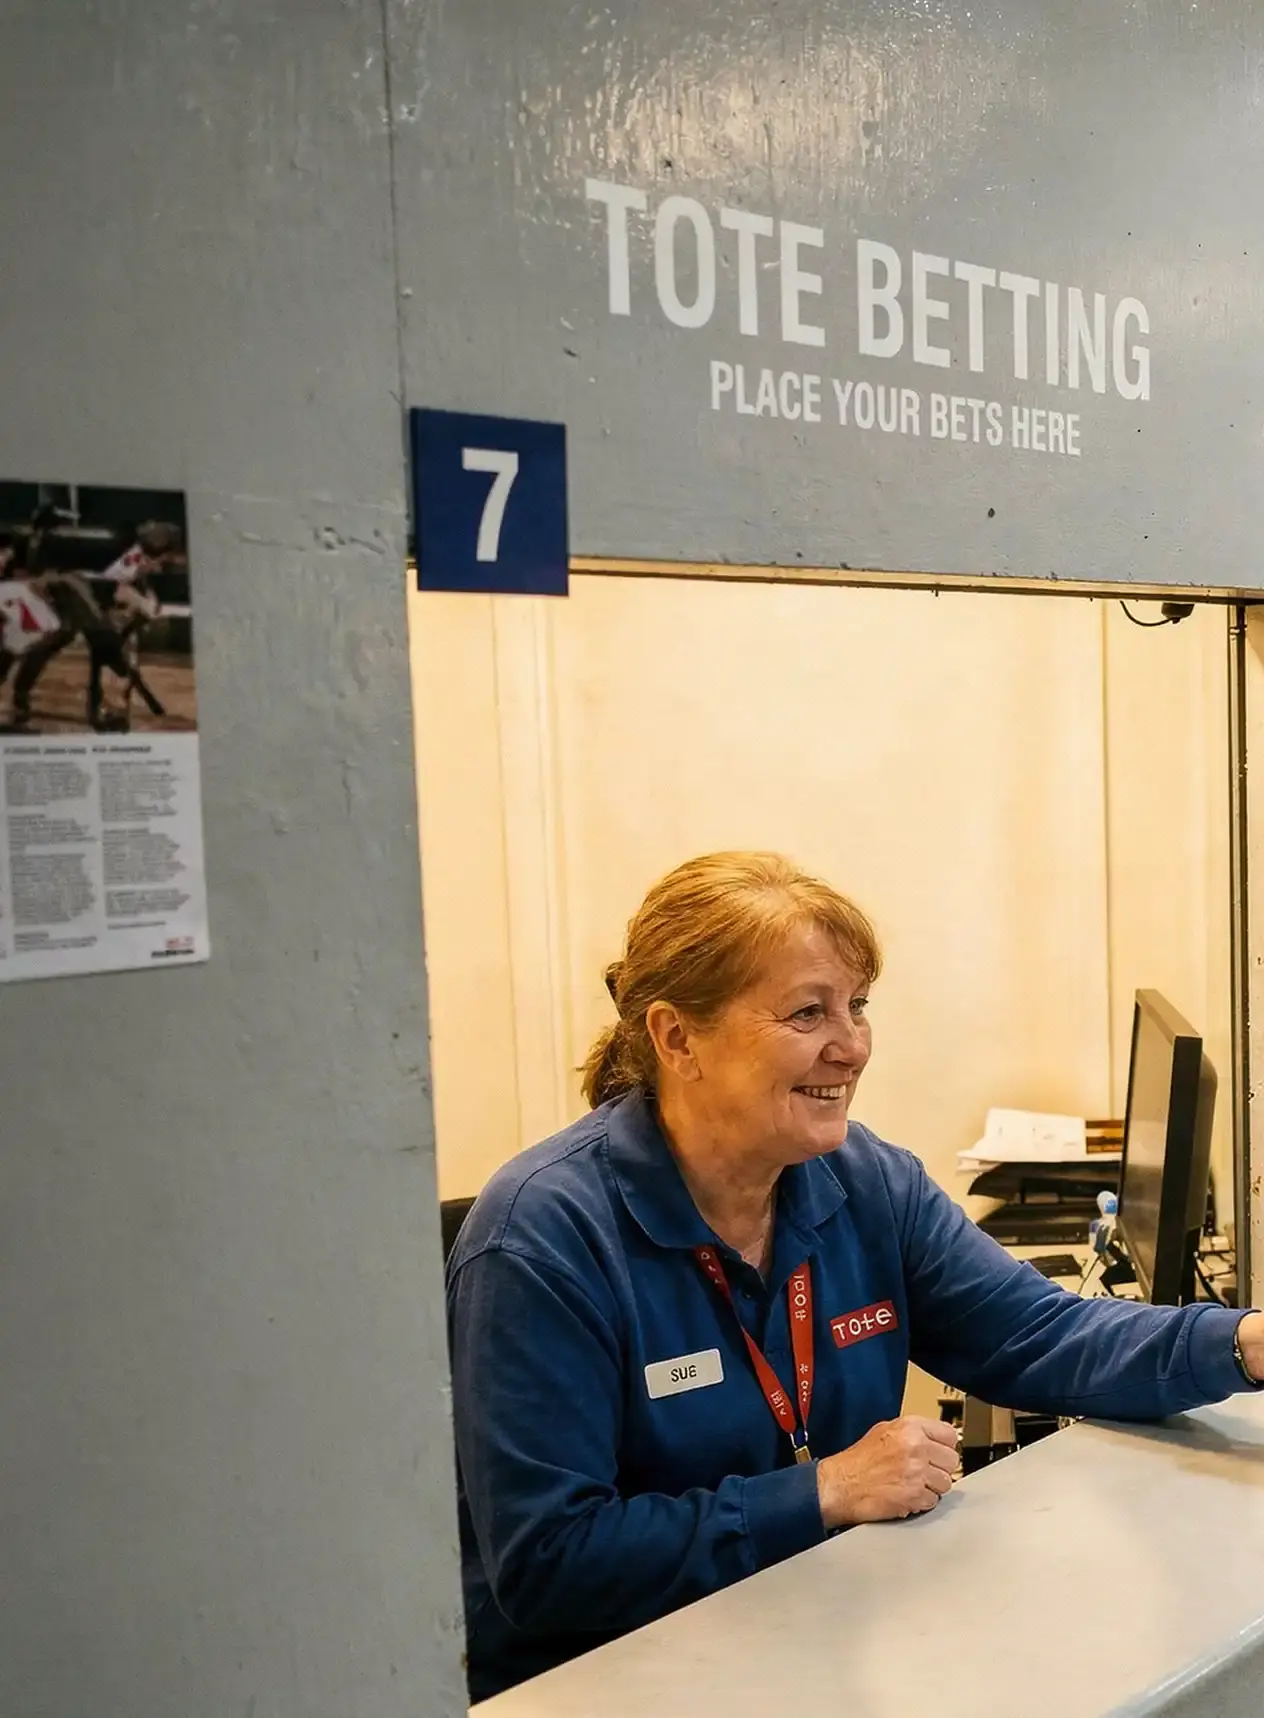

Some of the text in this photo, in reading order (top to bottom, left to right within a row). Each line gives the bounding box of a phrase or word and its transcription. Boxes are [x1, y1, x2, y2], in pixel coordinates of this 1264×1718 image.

[584, 177, 1151, 401] TOTE BETTING
[709, 359, 1082, 457] PLACE YOUR BETS HERE
[461, 446, 519, 563] 7
[670, 1364, 698, 1383] SUE
